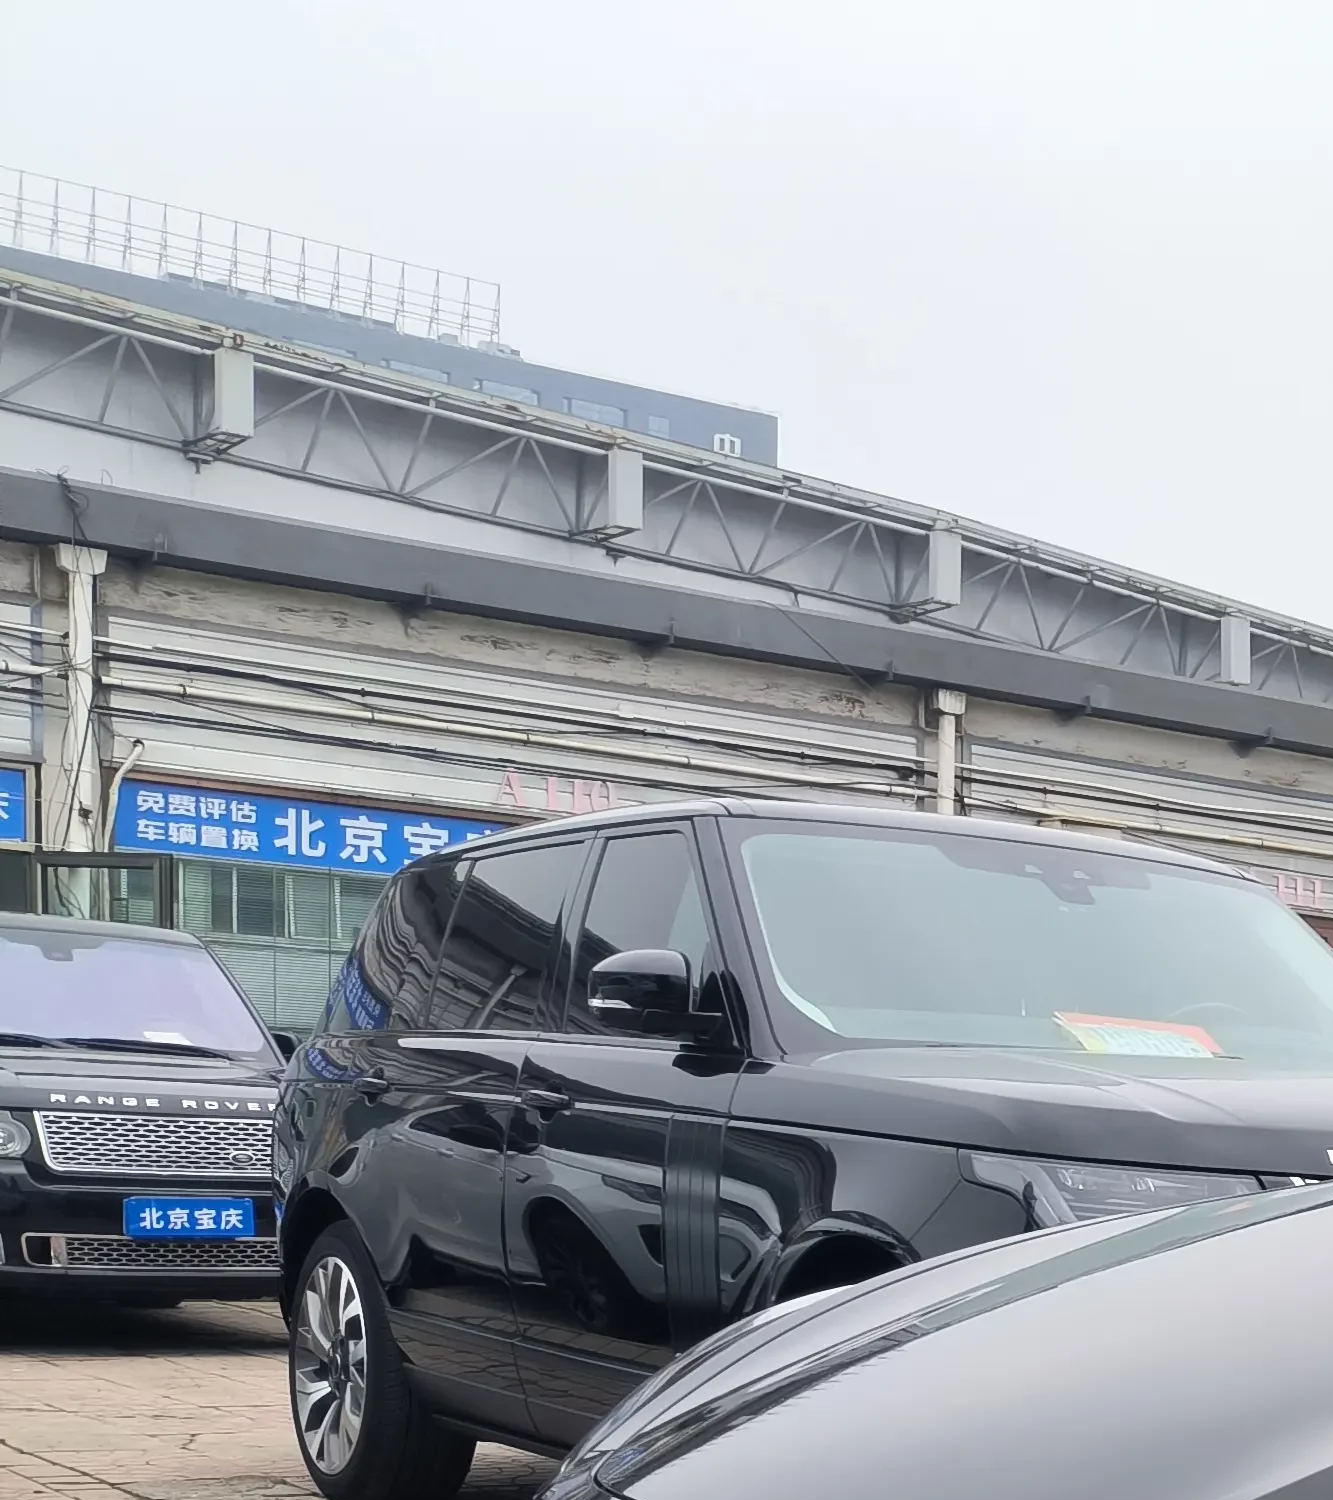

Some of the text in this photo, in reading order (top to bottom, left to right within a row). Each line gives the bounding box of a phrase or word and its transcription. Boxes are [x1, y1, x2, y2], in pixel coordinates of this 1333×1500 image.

[136, 790, 257, 824] 免费评估
[136, 819, 259, 852] 车辆置换
[273, 808, 495, 865] 北京宝
[50, 1093, 160, 1107] RANGE
[139, 1207, 244, 1230] 北京宝庆
